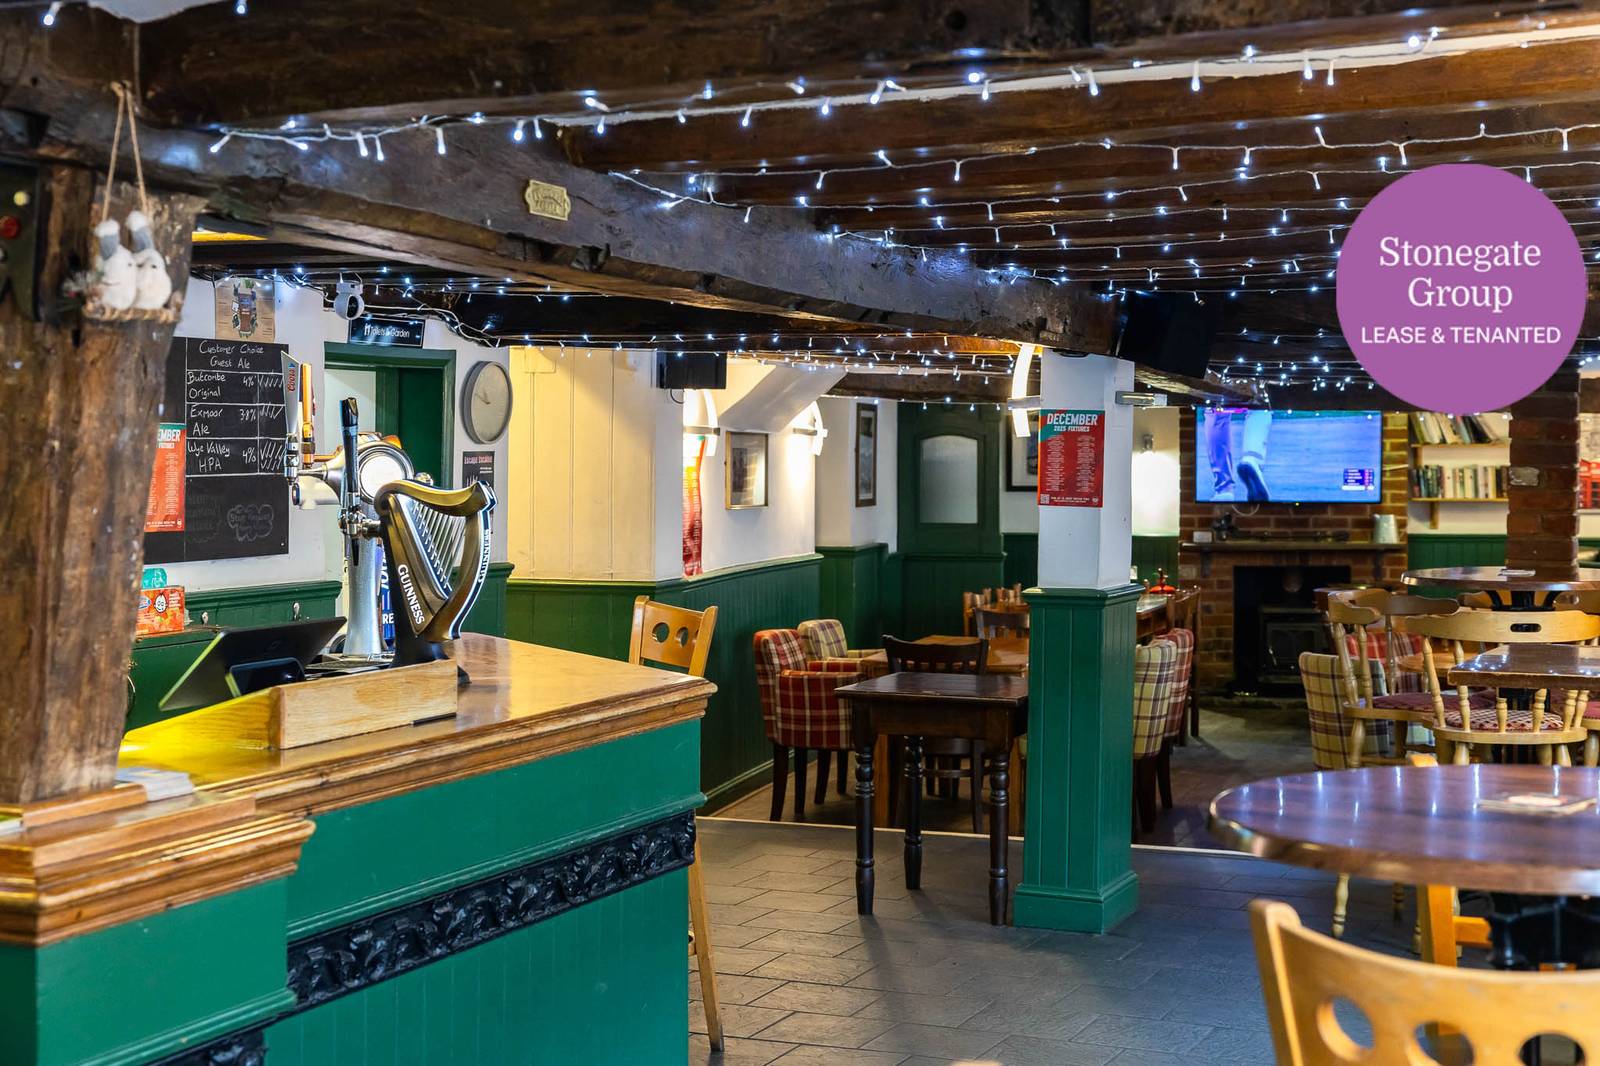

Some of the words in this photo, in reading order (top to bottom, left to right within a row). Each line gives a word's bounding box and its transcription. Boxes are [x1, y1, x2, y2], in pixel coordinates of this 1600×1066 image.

[391, 323, 410, 338] Garden
[199, 340, 235, 354] Customer
[239, 343, 265, 354] Choice
[210, 355, 232, 367] Guest
[237, 357, 250, 369] Ale
[187, 371, 226, 385] Butcombe
[242, 375, 255, 388] 4%
[287, 368, 296, 392] Coors
[189, 386, 221, 400] Original
[190, 405, 223, 418] Exmoor
[1046, 413, 1098, 426] DECEMBER
[192, 422, 210, 437] Ale
[1067, 425, 1090, 433] FIXTURES
[187, 441, 204, 457] Wye
[206, 441, 231, 457] Valley
[242, 447, 257, 464] 4%
[198, 457, 222, 473] HPA
[397, 564, 425, 625] GUINNESS
